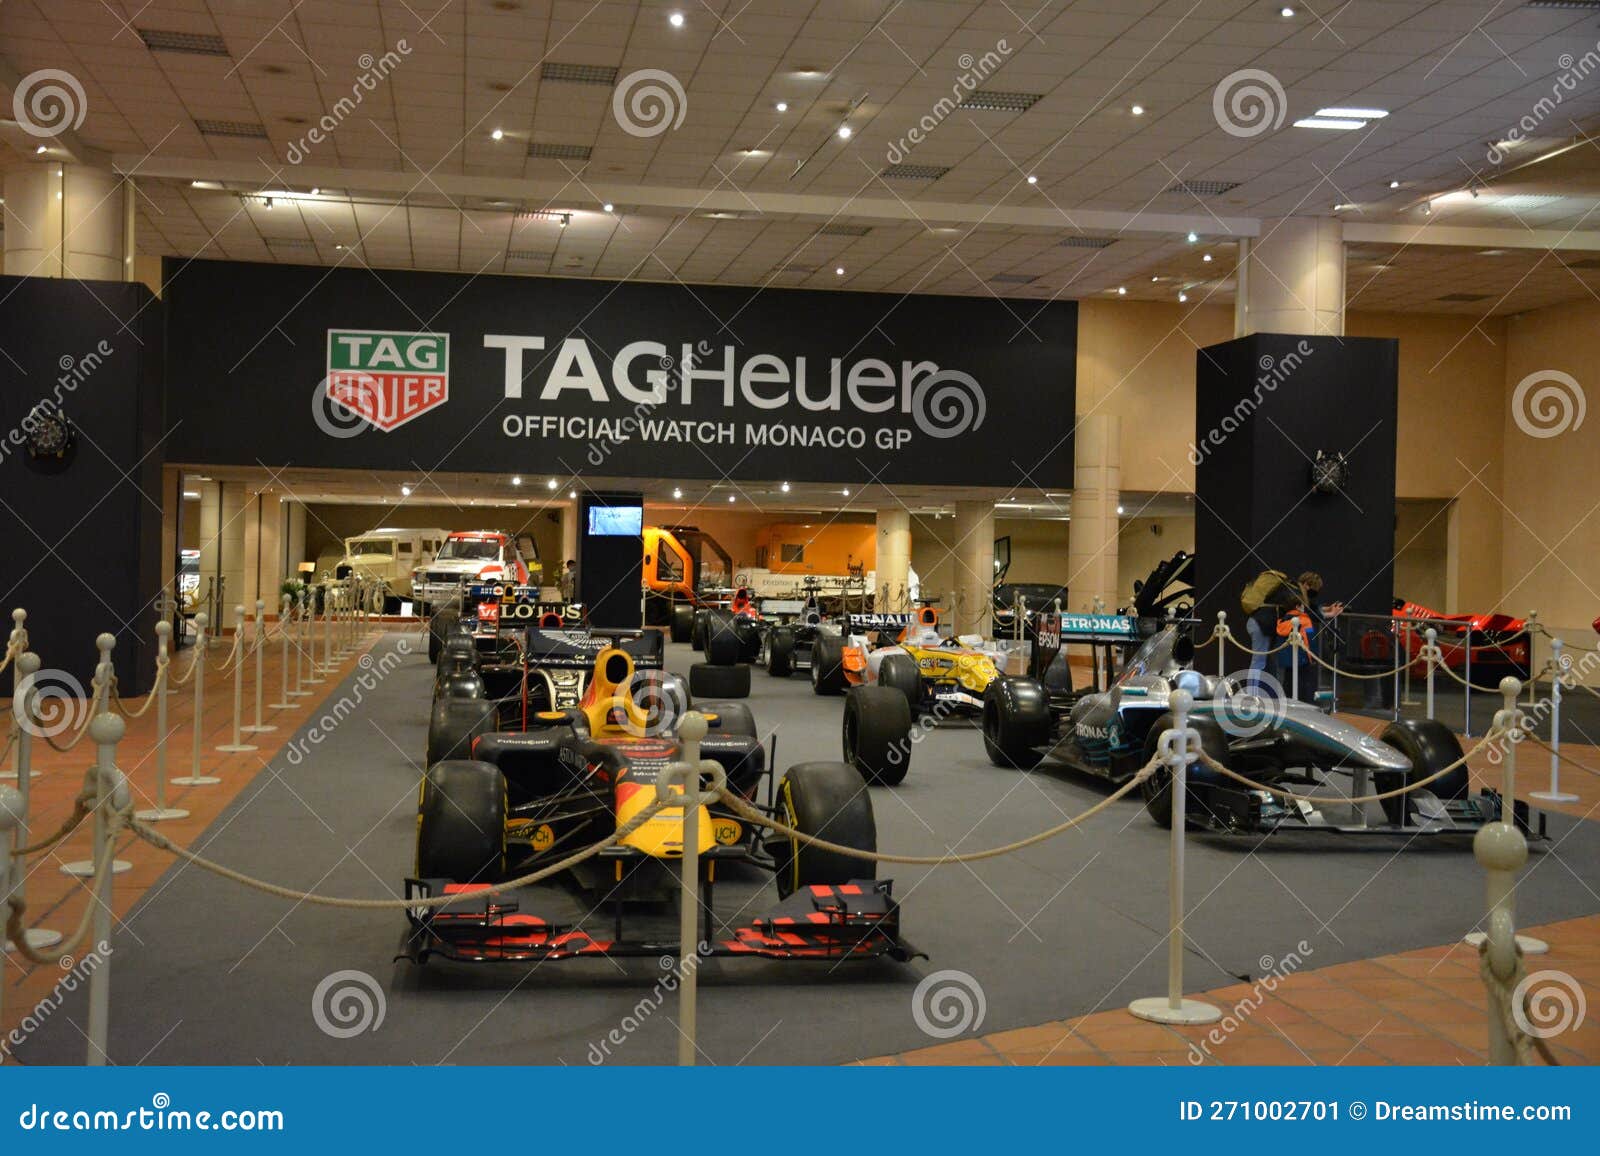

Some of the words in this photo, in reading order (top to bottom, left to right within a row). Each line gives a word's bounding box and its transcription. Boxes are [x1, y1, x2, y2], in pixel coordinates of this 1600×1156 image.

[338, 336, 438, 369] TAG
[483, 334, 940, 414] TAGHeuer
[334, 374, 441, 422] HEUER
[503, 415, 630, 440] OFFICIAL
[639, 419, 735, 444] WATCH
[745, 424, 866, 449] MONACO
[875, 428, 912, 449] GP
[500, 604, 581, 620] LOTUS
[1061, 616, 1130, 631] ETRONAS
[714, 826, 737, 840] UCH
